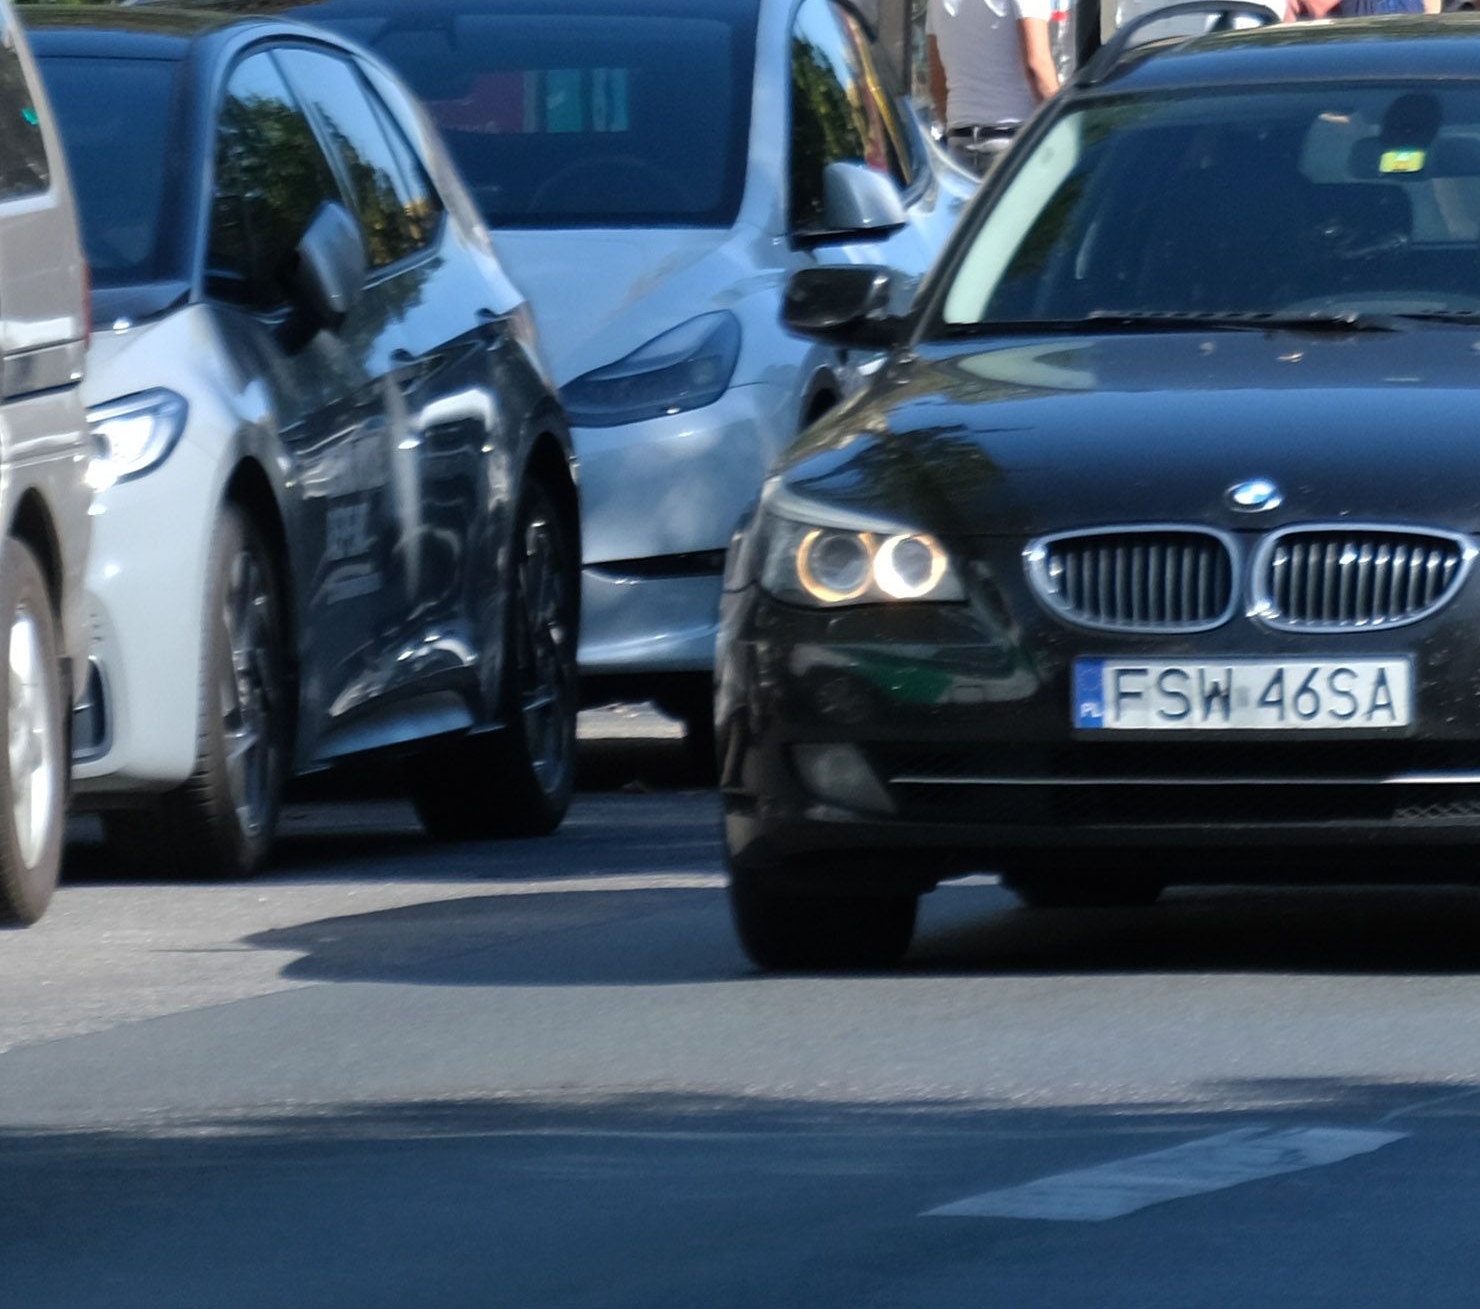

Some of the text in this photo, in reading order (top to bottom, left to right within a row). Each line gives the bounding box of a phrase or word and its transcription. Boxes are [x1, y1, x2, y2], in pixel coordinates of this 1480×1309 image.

[1081, 667, 1396, 722] PL FSW 46SA
